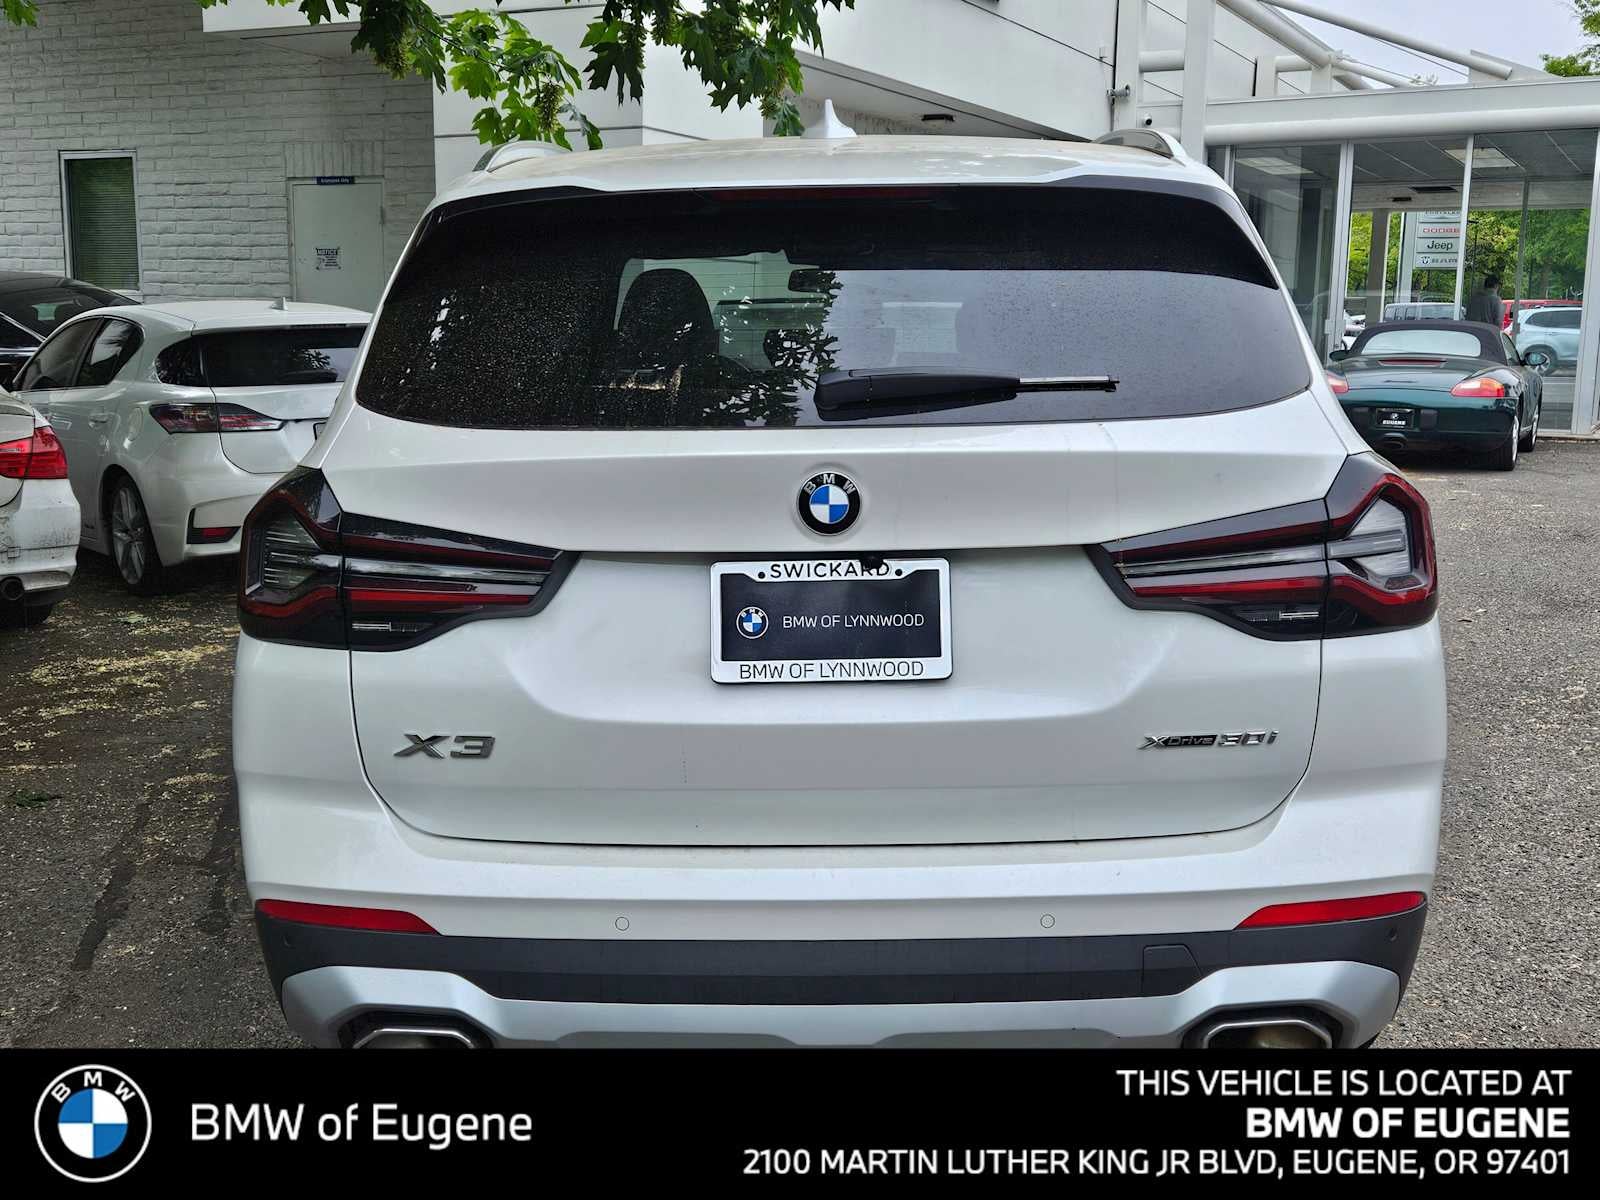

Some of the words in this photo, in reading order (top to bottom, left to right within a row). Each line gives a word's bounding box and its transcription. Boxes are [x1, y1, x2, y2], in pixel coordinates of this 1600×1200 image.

[1427, 240, 1453, 251] Jeep
[804, 473, 855, 495] BMW
[783, 616, 817, 629] BMW
[821, 615, 841, 628] OF
[844, 614, 925, 628] LYNNWOOD
[739, 663, 785, 680] BMW
[789, 662, 815, 679] OF
[820, 661, 925, 678] LYNNWOOD
[393, 733, 496, 759] X3
